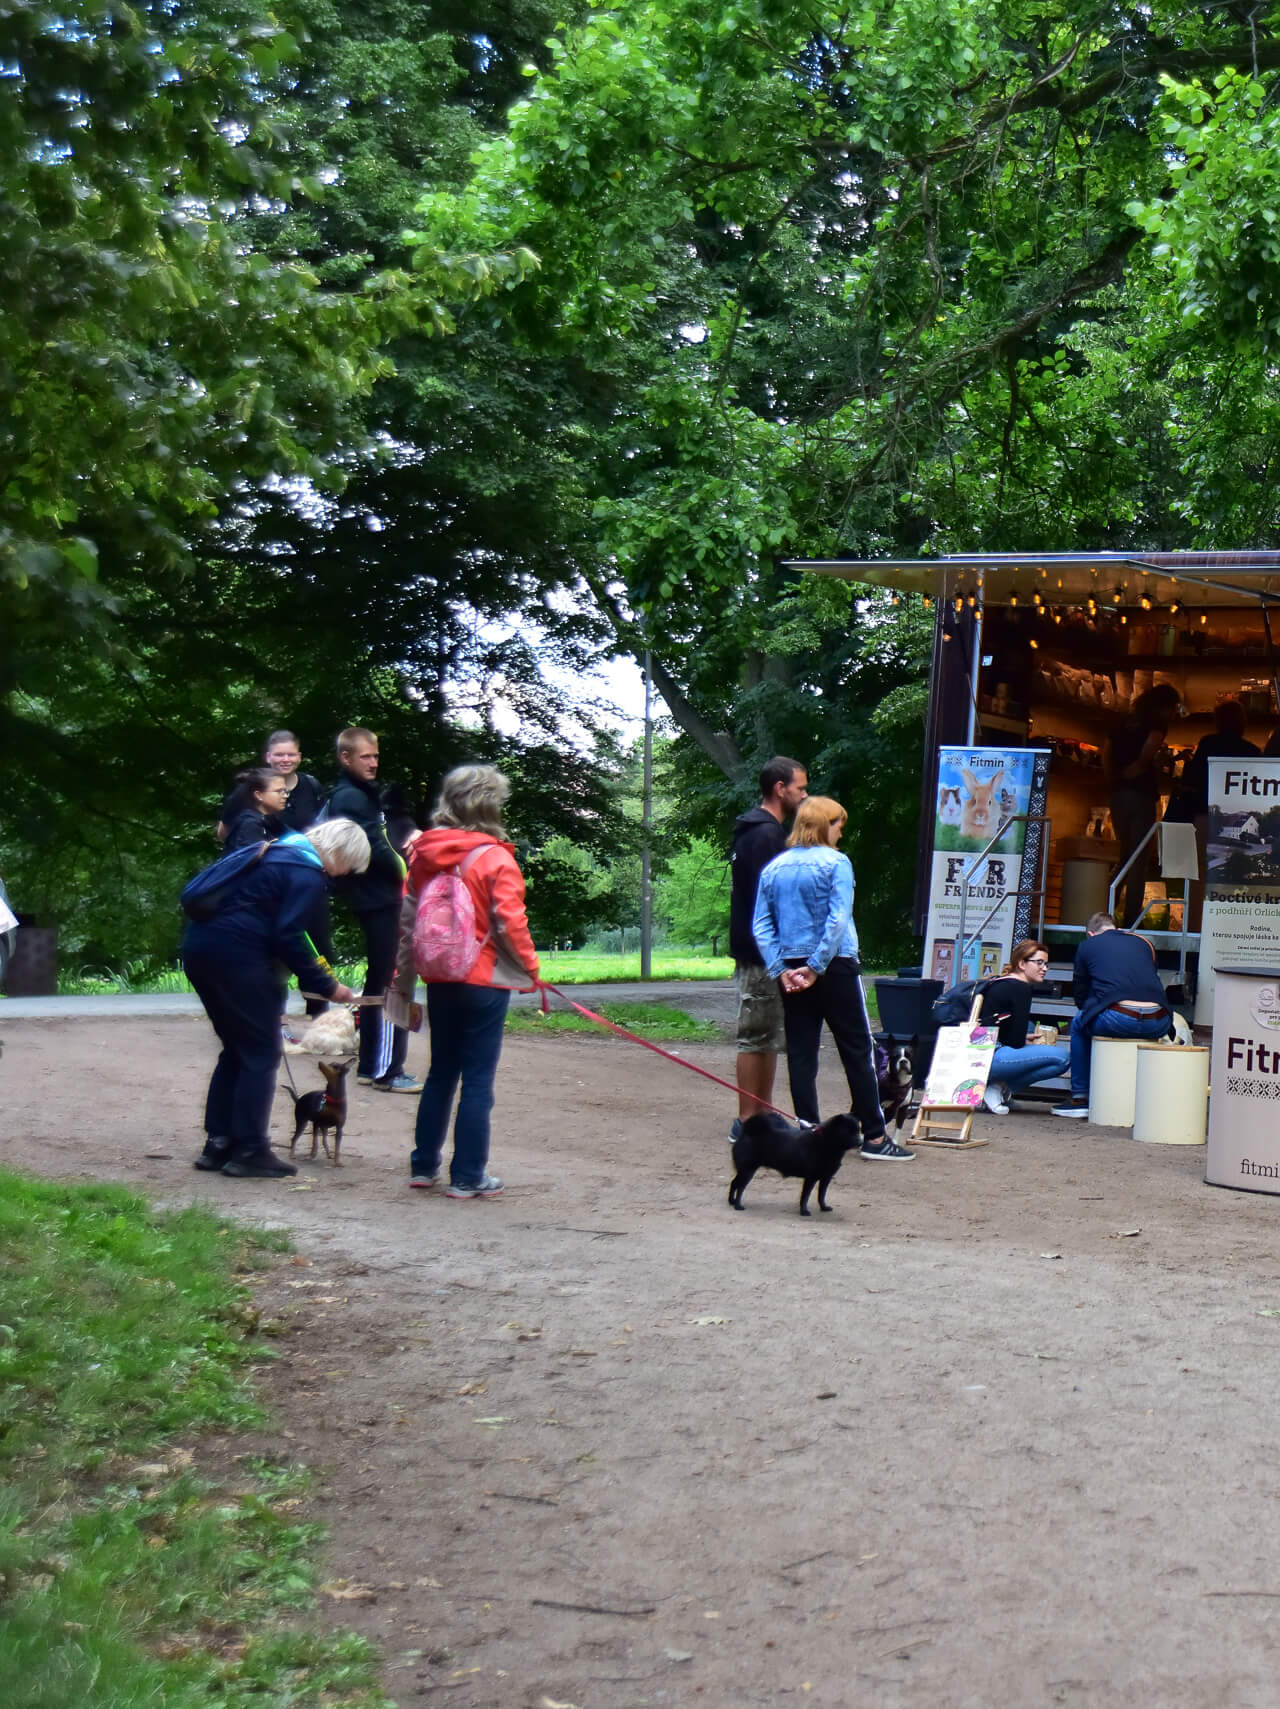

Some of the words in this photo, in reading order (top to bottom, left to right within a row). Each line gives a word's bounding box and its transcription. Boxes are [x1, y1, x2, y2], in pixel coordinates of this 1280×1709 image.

[969, 756, 1004, 768] Fitmin
[944, 885, 1006, 899] FRENDS
[1208, 891, 1262, 904] Poctivé
